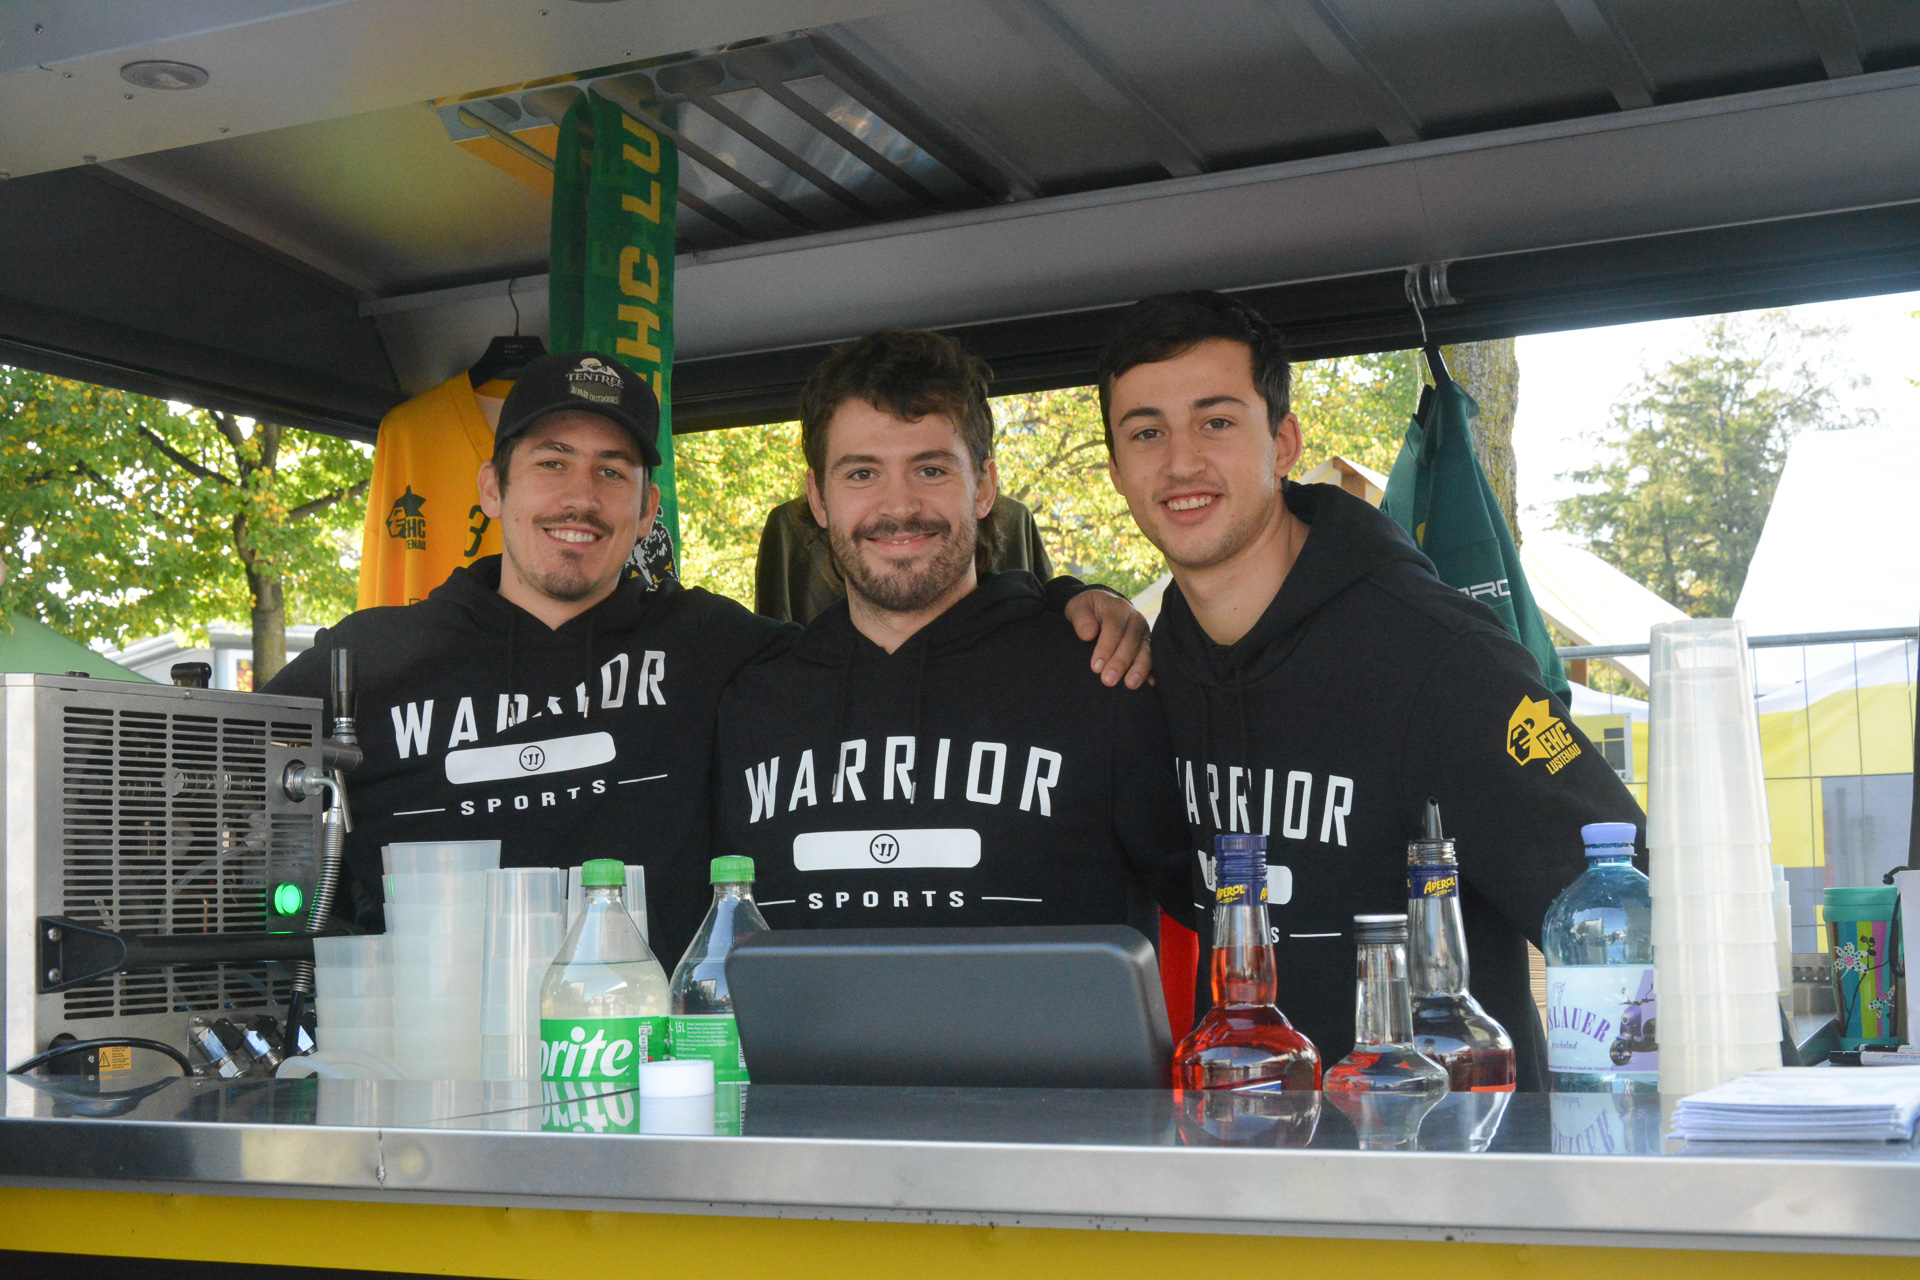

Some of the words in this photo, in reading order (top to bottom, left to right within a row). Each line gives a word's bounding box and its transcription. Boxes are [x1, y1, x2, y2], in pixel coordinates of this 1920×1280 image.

[565, 372, 624, 389] TENTREE
[1538, 721, 1573, 757] EHC
[1545, 742, 1582, 775] LUSTENAU
[744, 735, 1062, 824] WARRIOR
[460, 779, 606, 816] SPORTS
[1175, 757, 1354, 847] ARRIOR
[808, 890, 965, 910] SPORTS
[1216, 884, 1246, 901] APEROL
[1424, 876, 1456, 895] APEROL
